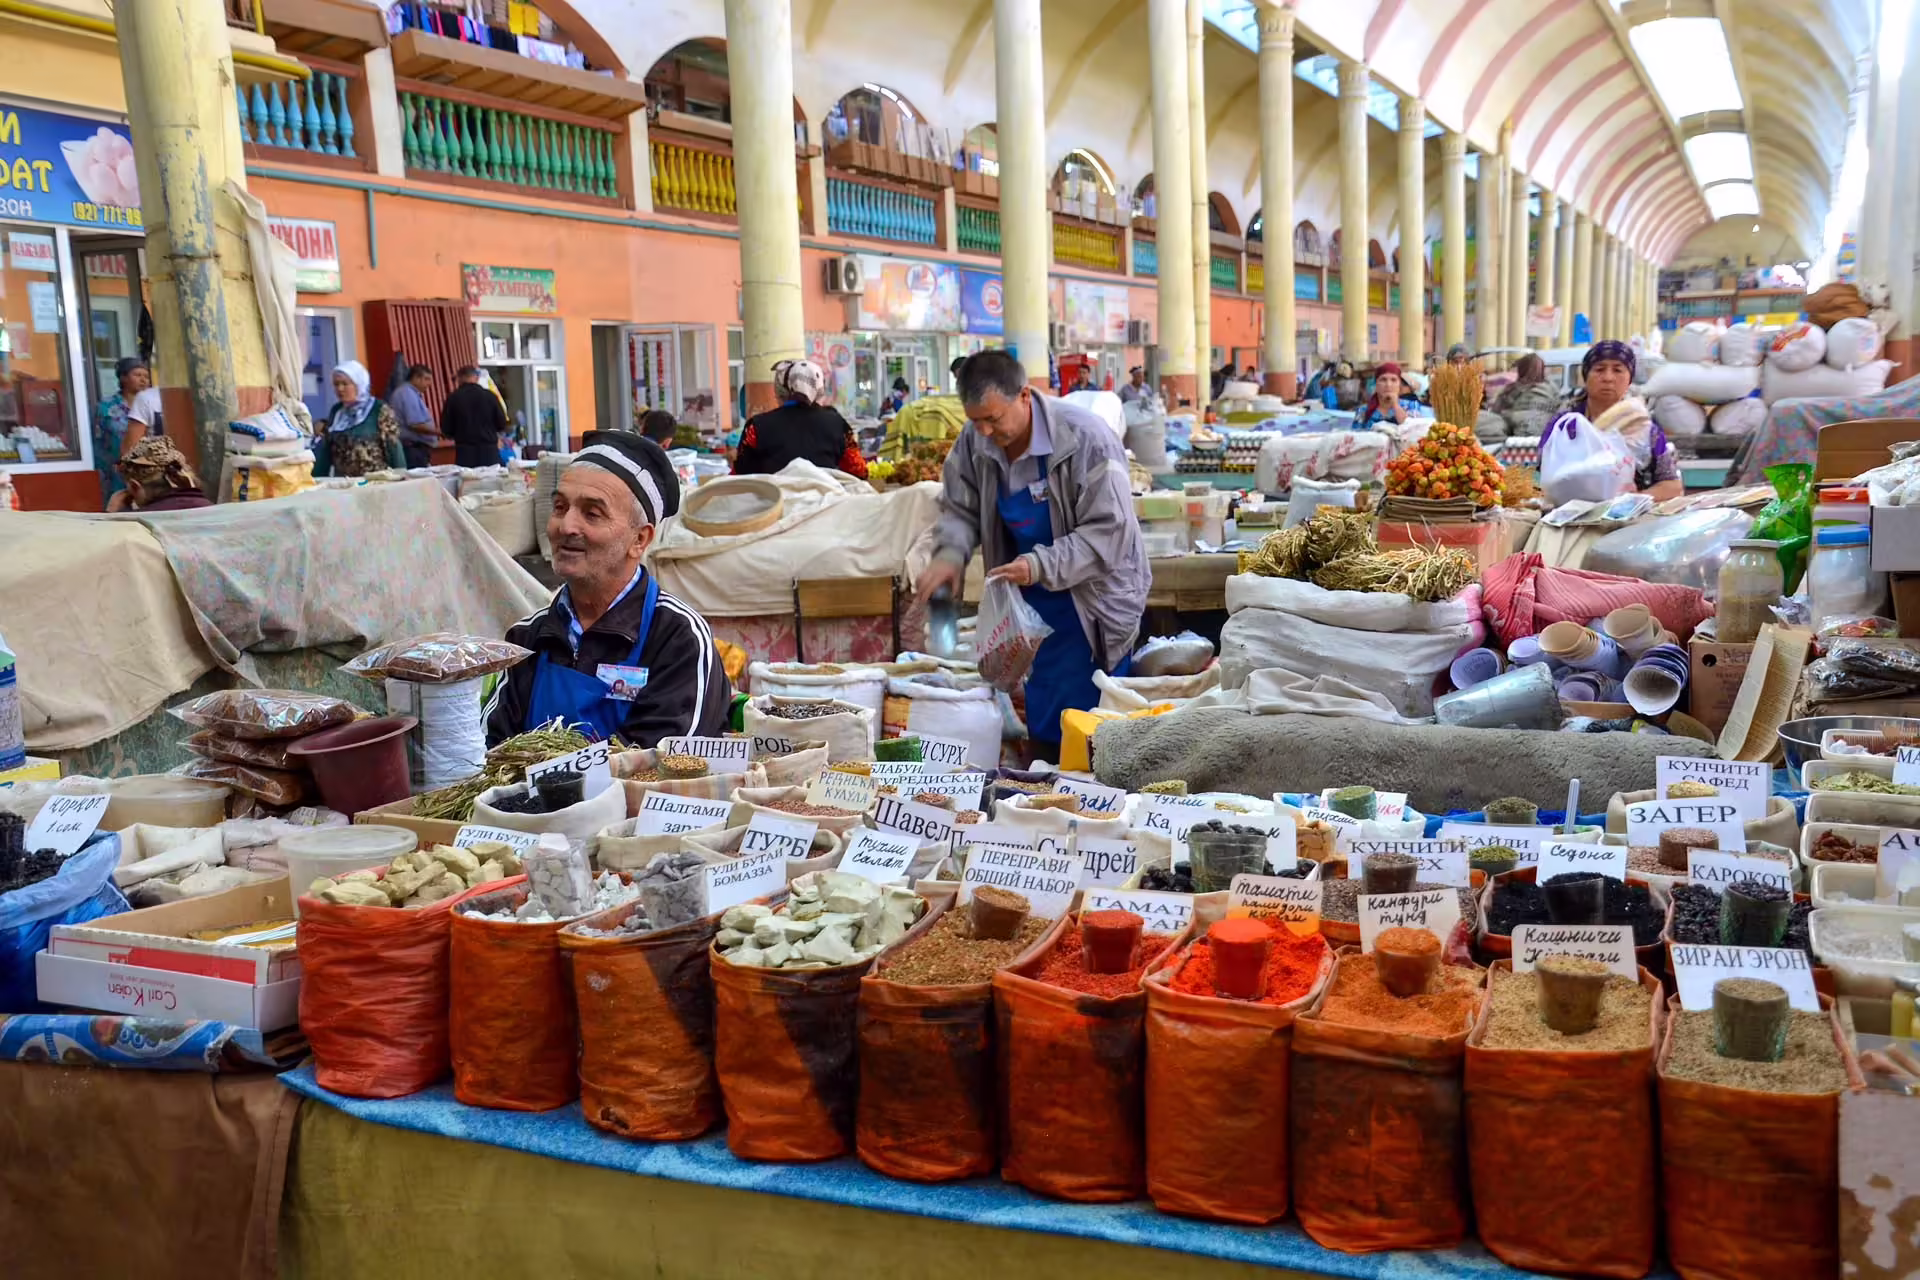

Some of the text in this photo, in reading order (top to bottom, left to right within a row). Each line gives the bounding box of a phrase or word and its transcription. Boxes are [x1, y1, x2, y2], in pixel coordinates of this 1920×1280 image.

[668, 740, 748, 759] КАШНИЧ
[931, 742, 967, 766] СУРХ
[1667, 760, 1760, 776] КУНЧИТИ
[643, 796, 728, 818] Шалгами
[1629, 805, 1737, 824] ЗАГЕР
[745, 829, 808, 858] ТУРБ
[1351, 841, 1466, 853] КУНЧИТИ
[980, 849, 1072, 875] ПЕРЕПРАВИ
[713, 865, 773, 888] БОМАЗЗА
[1022, 877, 1076, 895] НАБОР
[1691, 863, 1790, 891] КАРОКОТ
[1746, 949, 1809, 970] ЭРОН
